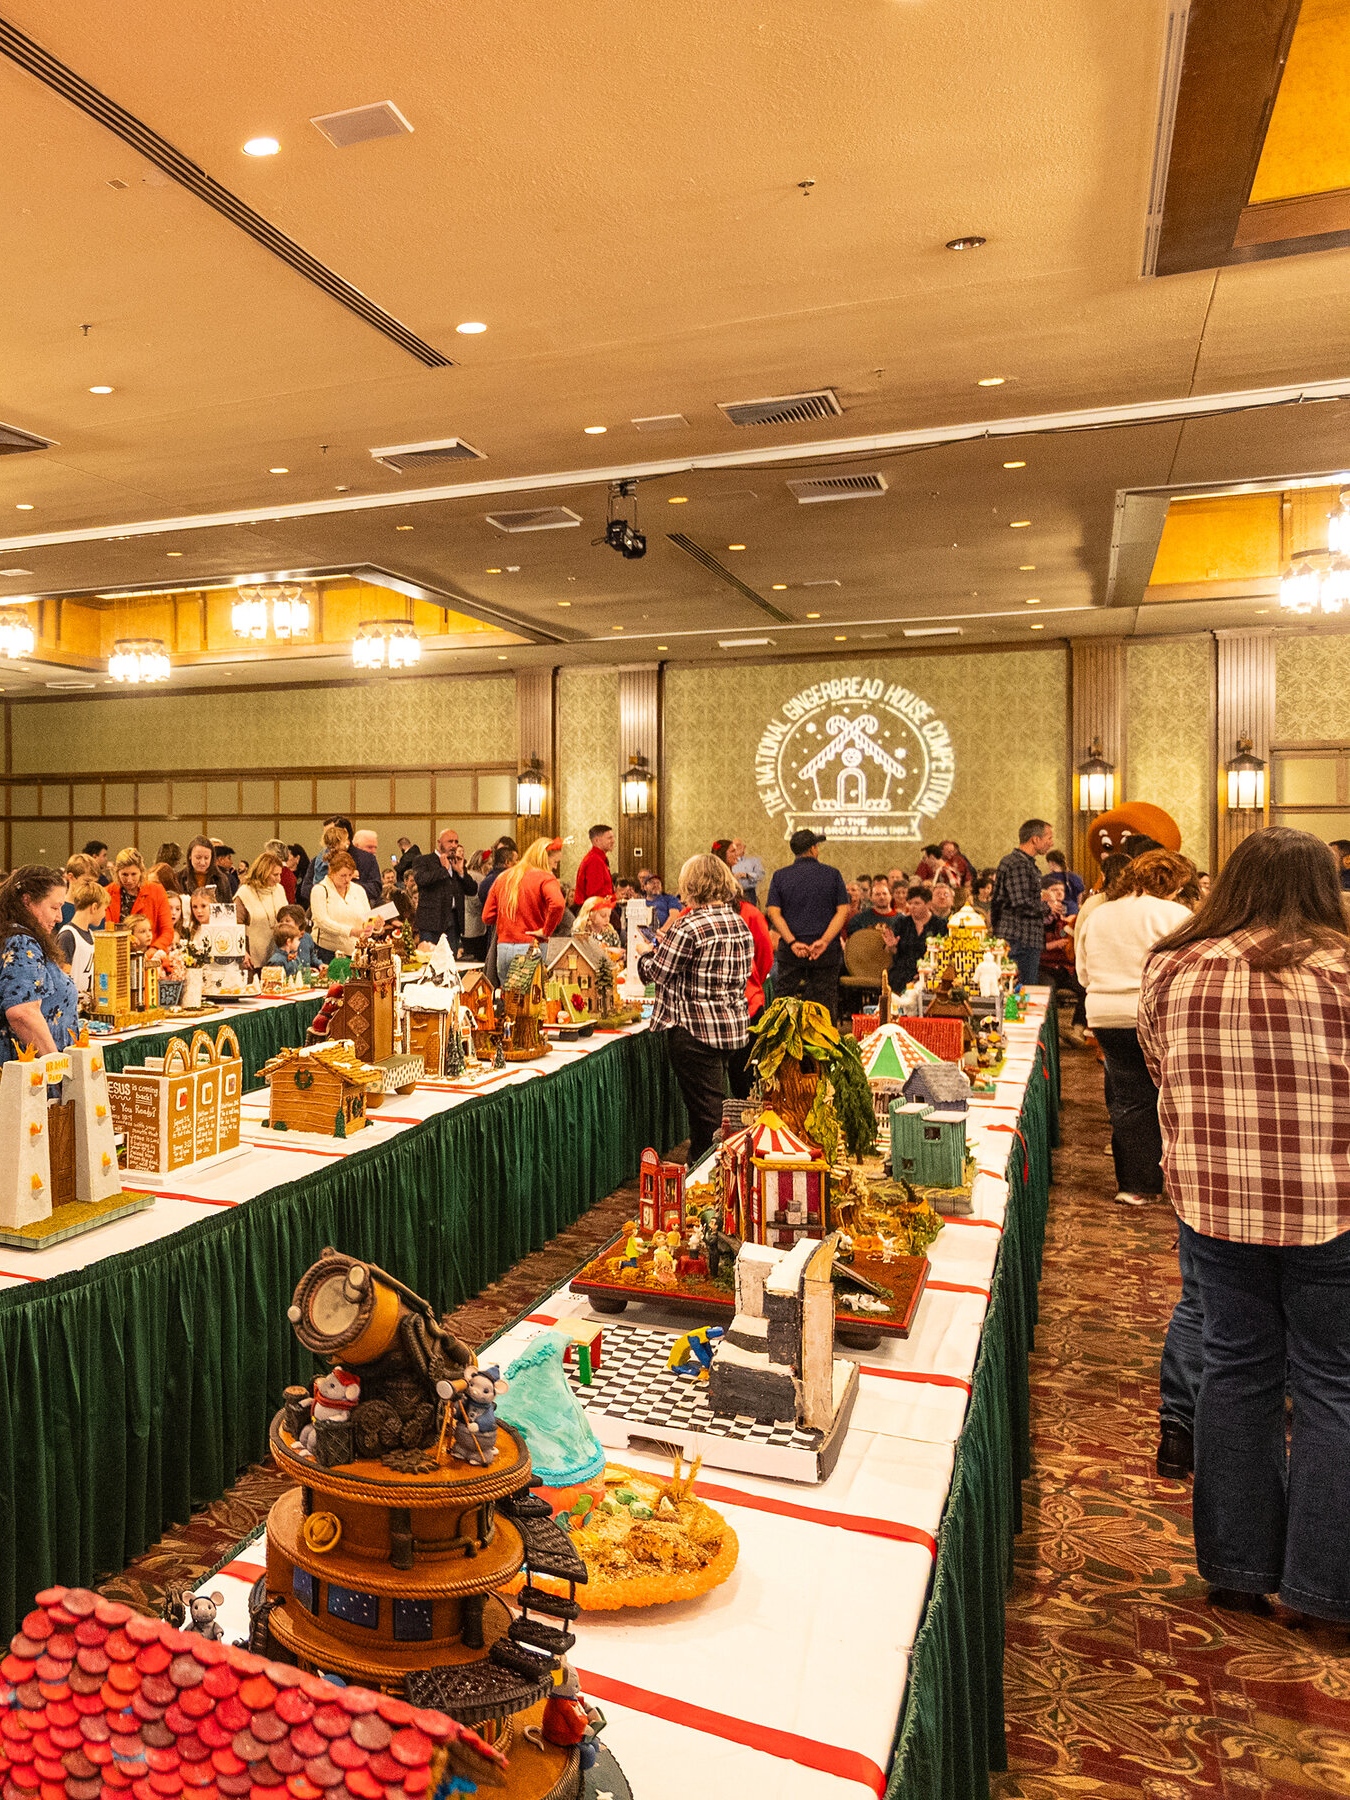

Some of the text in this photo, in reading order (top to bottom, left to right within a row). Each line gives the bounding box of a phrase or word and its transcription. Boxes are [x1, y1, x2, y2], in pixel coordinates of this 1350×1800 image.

[755, 677, 956, 819] THE NATIONAL GINGERBREAD HOUSE COMPETITION
[833, 817, 868, 826] AT THE
[824, 826, 859, 835] GROVE
[860, 826, 888, 835] PARK
[889, 826, 909, 835] INN
[107, 1081, 131, 1096] ESUS
[138, 1085, 159, 1097] coming
[120, 1103, 133, 1113] You
[134, 1104, 157, 1118] Ready?
